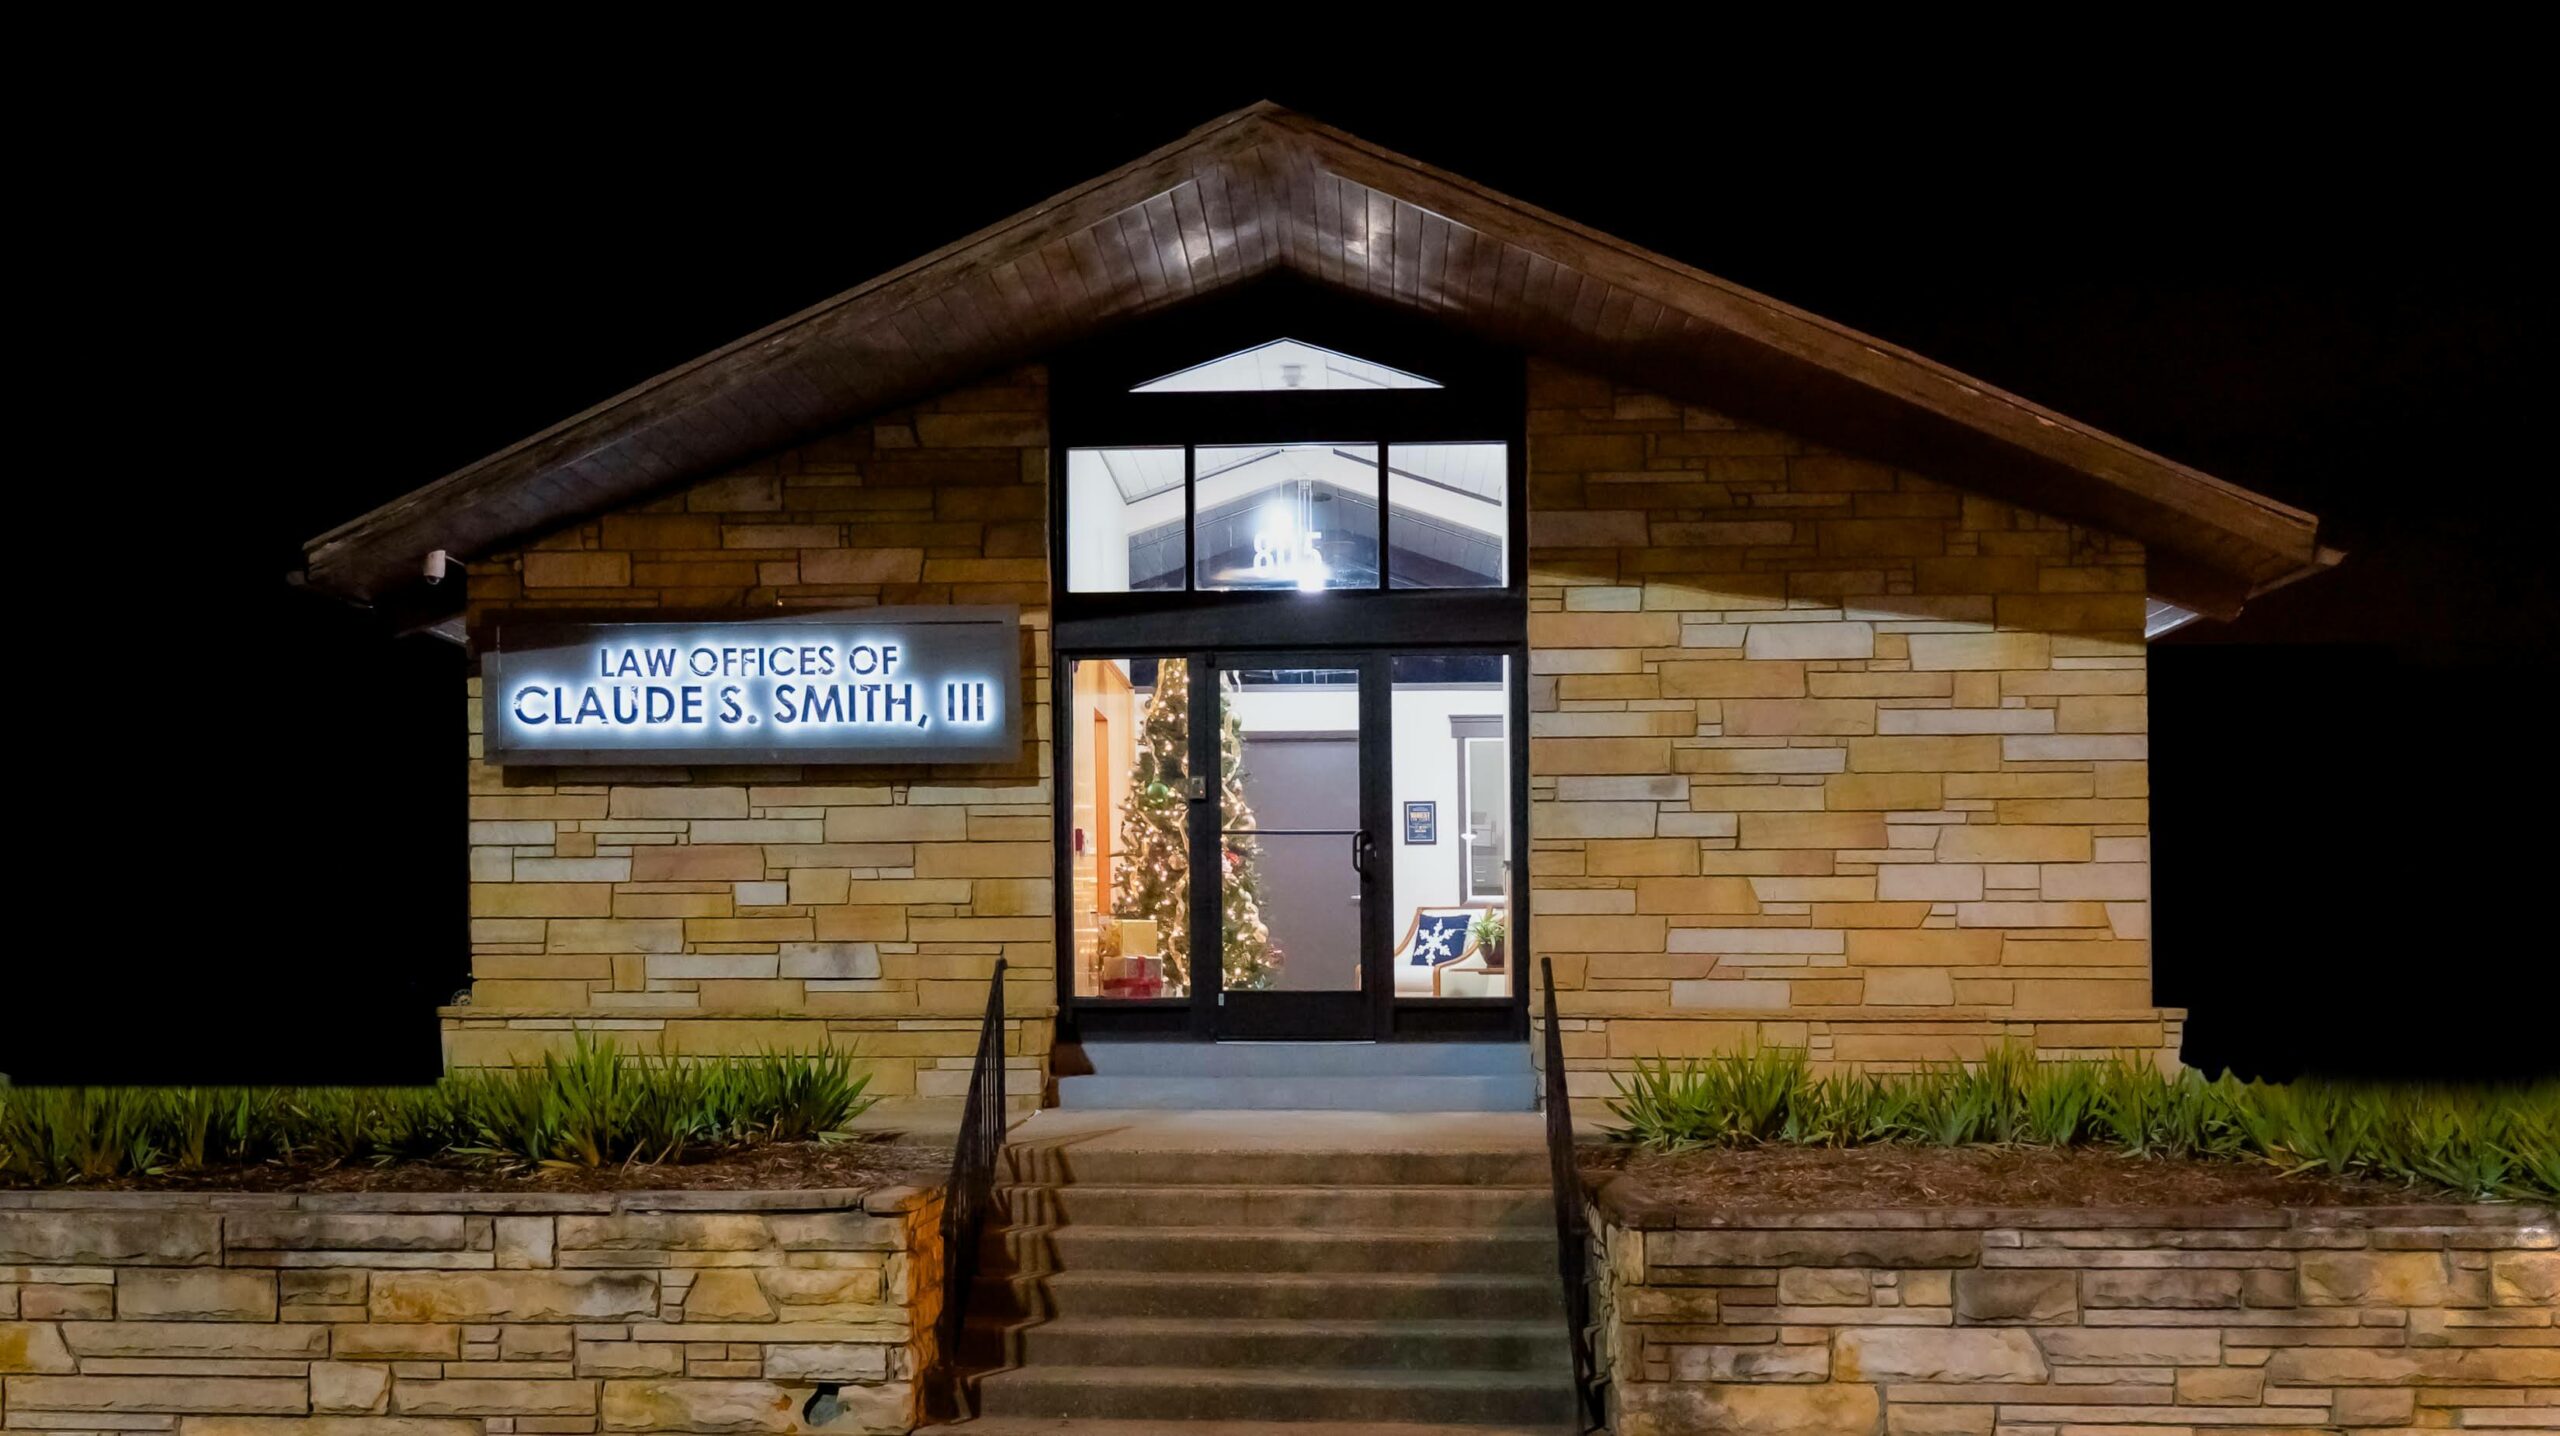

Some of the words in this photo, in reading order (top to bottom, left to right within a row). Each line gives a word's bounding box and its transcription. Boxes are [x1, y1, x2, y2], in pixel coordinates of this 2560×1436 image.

[1252, 531, 1323, 575] 805
[601, 648, 677, 678] LAW
[689, 645, 836, 677] OFFICES
[849, 645, 898, 675] OF
[514, 685, 703, 725] CLAUDE
[719, 685, 758, 725] S.
[774, 683, 928, 729] SMITH,
[947, 682, 985, 722] III
